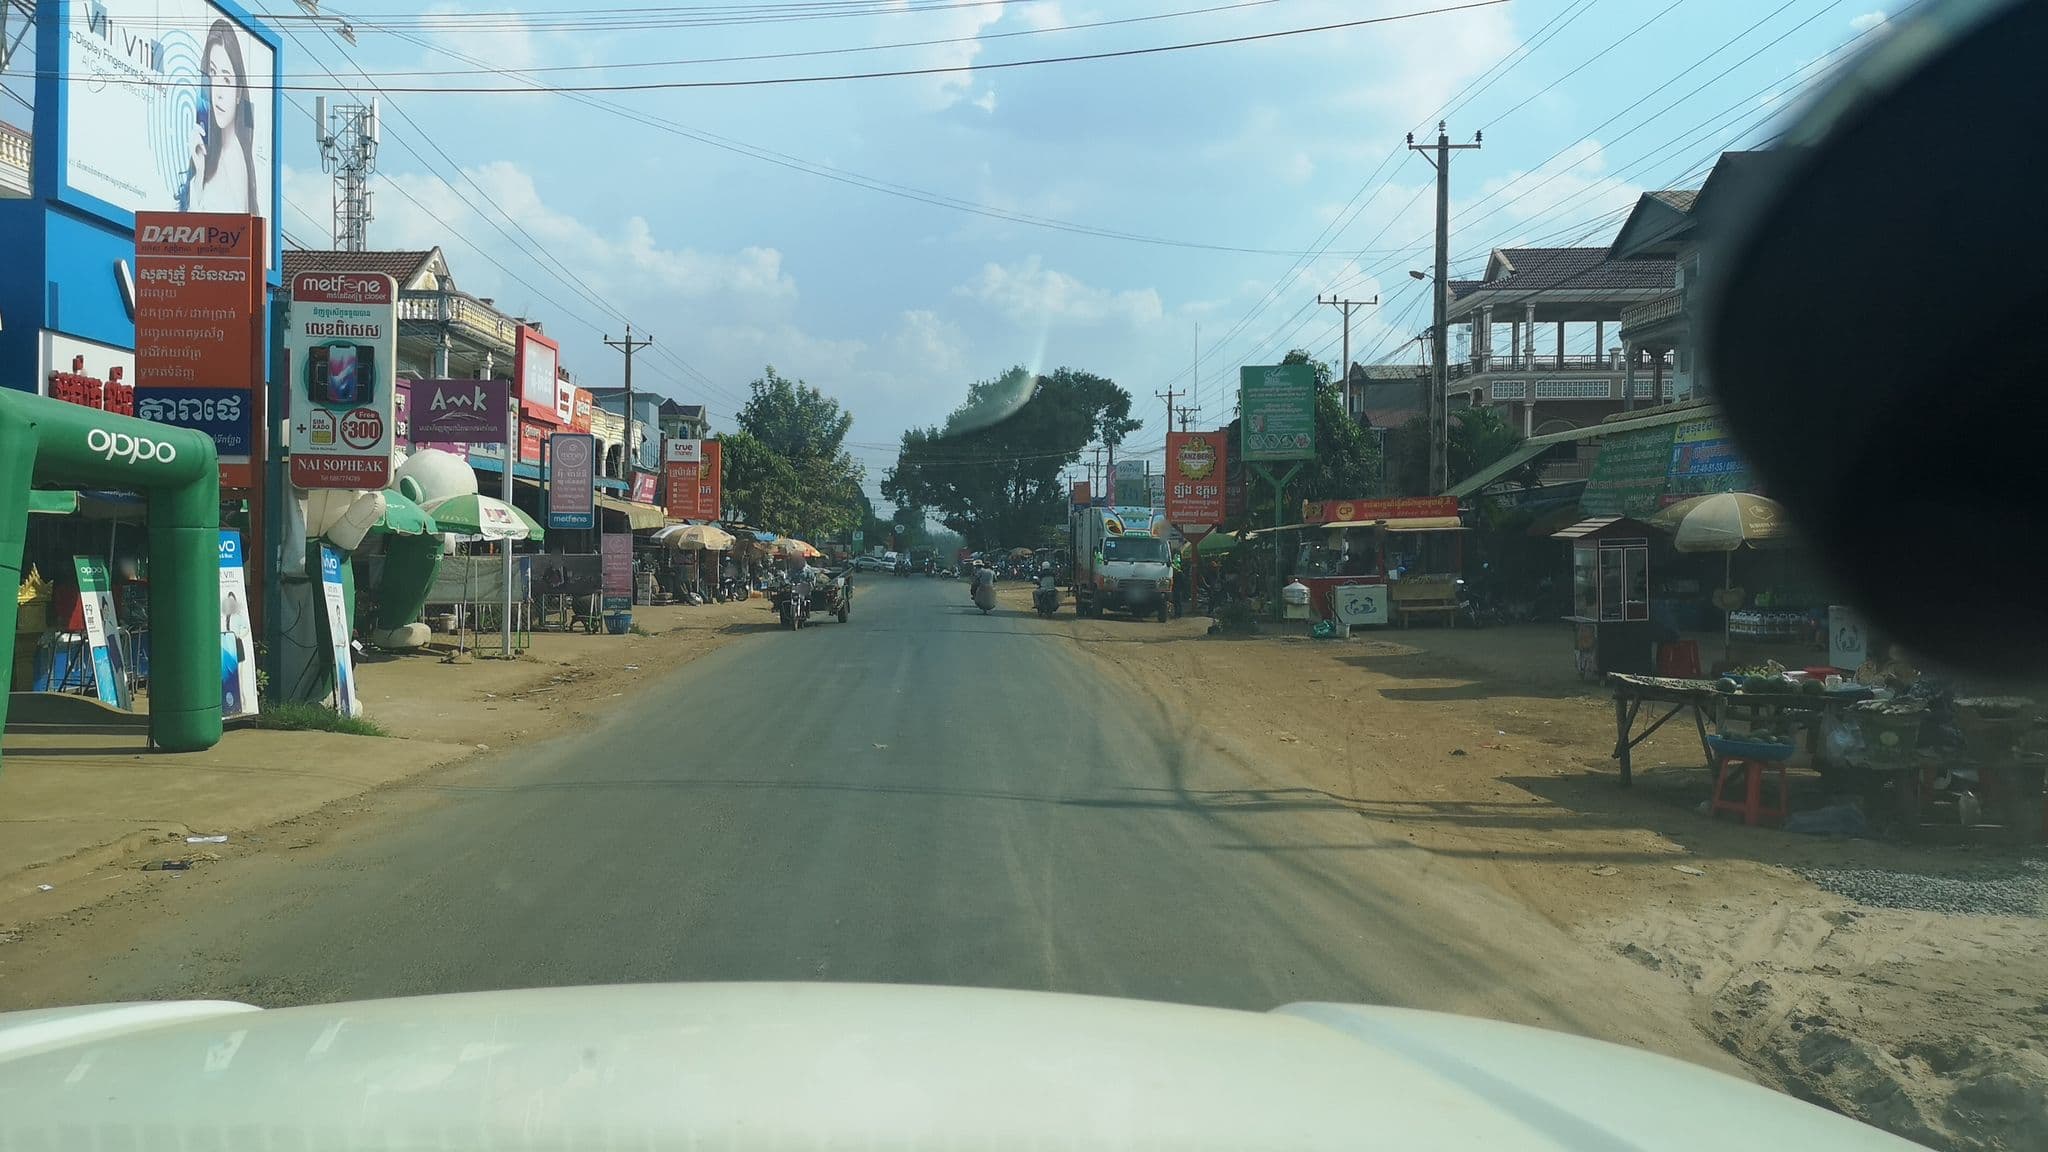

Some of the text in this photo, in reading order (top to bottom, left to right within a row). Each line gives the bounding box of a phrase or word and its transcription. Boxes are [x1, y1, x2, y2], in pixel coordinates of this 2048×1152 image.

[141, 226, 240, 248] DARA Pay
[342, 421, 379, 439] $300
[87, 429, 176, 464] oppo
[675, 443, 693, 451] true
[298, 458, 382, 472] NAI SOPHEAK
[1339, 505, 1353, 515] CP
[553, 514, 588, 523] metfone
[80, 566, 103, 576] oppo
